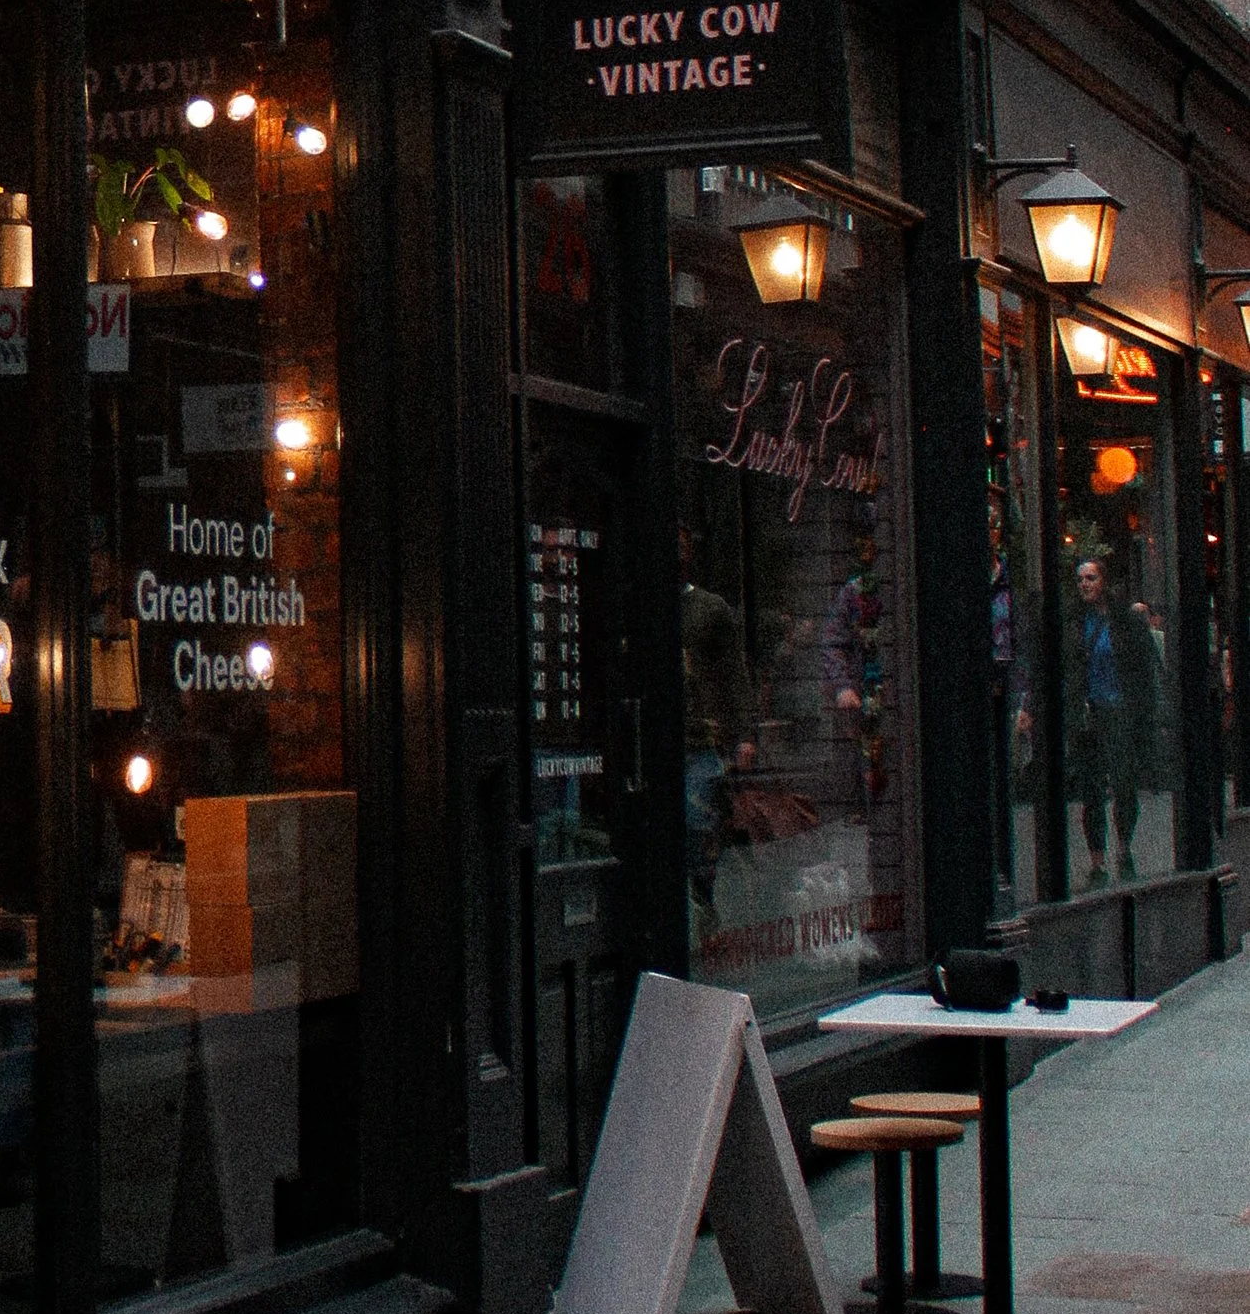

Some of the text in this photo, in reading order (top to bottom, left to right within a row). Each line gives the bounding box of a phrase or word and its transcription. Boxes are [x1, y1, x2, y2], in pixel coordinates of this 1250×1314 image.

[573, 0, 784, 52] LUCKY COW
[168, 501, 277, 559] Home of
[136, 571, 306, 628] Great British
